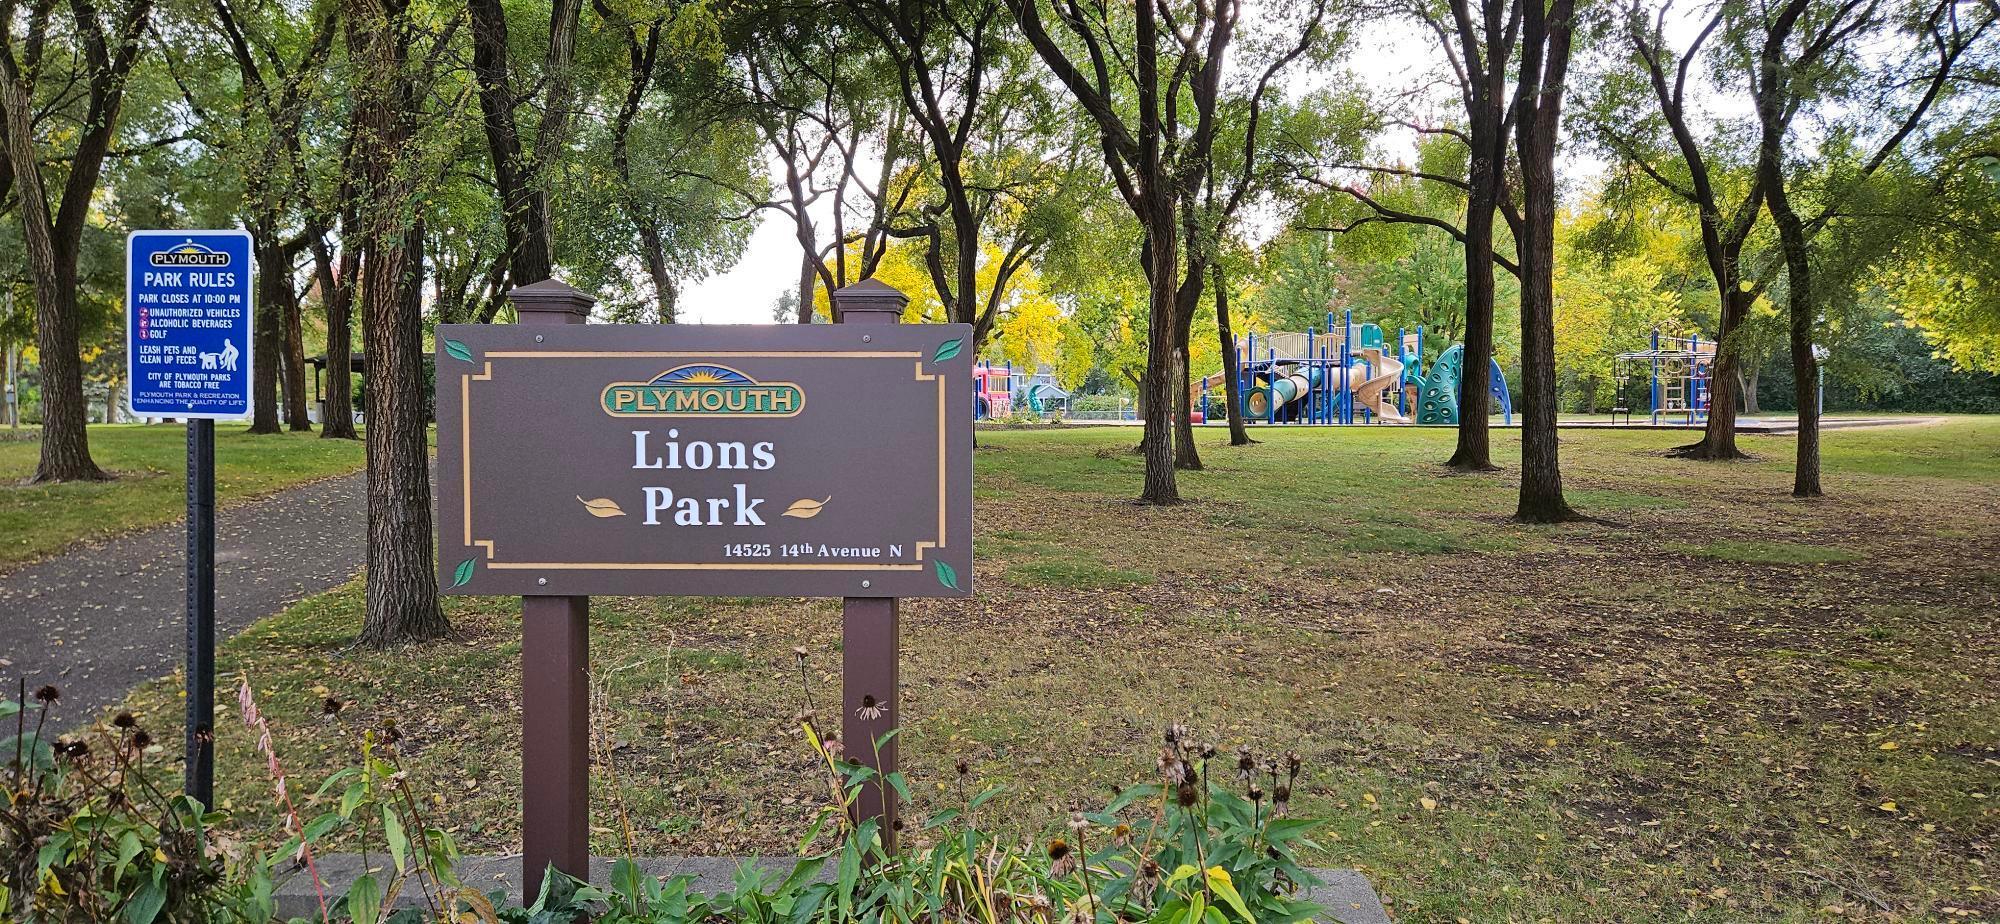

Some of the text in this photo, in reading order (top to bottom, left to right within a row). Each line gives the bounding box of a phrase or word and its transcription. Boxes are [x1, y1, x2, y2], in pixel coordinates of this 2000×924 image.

[155, 254, 226, 264] PLYMOUTH
[144, 272, 235, 287] PARK RULES
[139, 294, 240, 303] PARK CLOSES AT 10:00 PM
[150, 308, 240, 317] UNAUTHORIZED VEHICLES
[150, 319, 232, 328] ALCOHOLIC BEVERAGES
[150, 330, 167, 338] GOLF
[140, 346, 196, 354] LEASH PETS AND
[140, 356, 196, 364] CLEAN UP FECES
[148, 372, 162, 380] CITY
[175, 373, 208, 381] PLYMOUTH
[211, 373, 230, 381] PARKS
[204, 381, 219, 389] FREE
[614, 390, 793, 411] PLYMOUTH
[632, 428, 775, 470] Lions
[642, 484, 765, 526] Park
[723, 543, 903, 558] 14525 14th Avenue N
